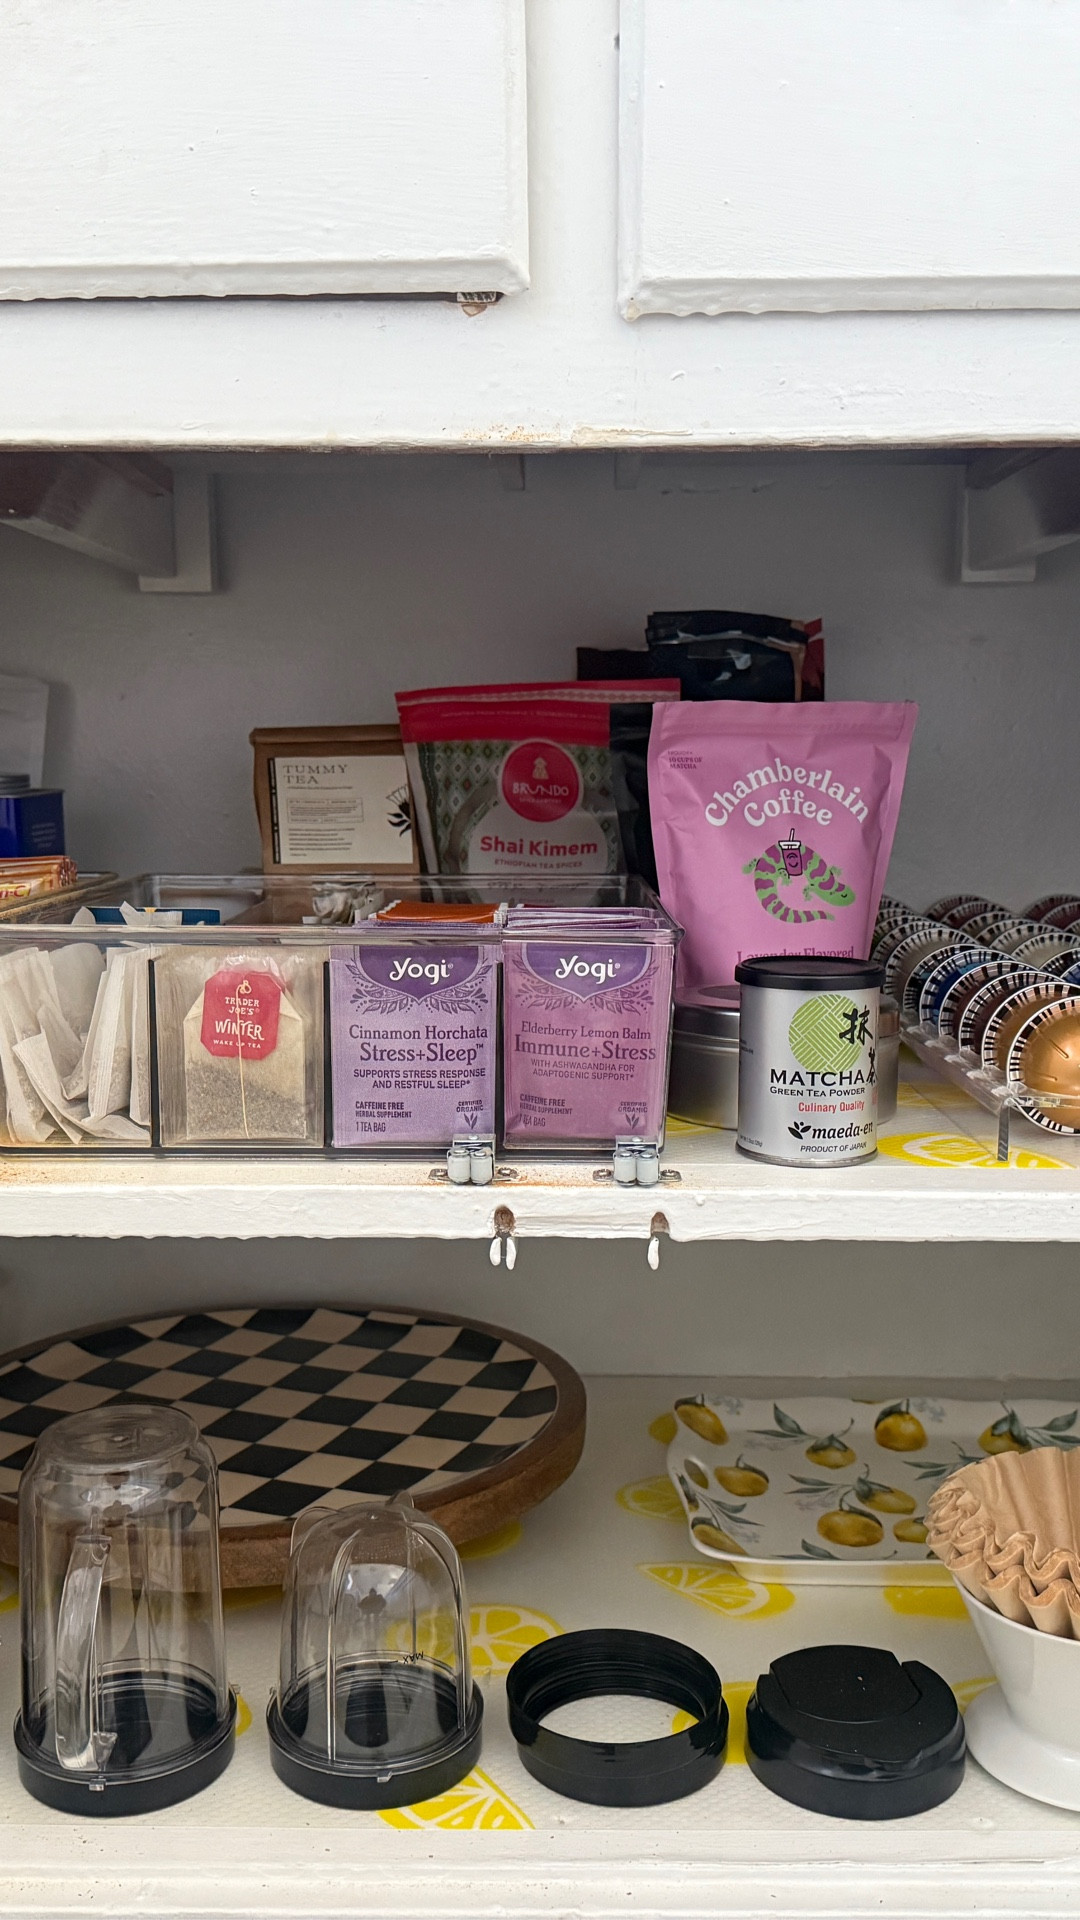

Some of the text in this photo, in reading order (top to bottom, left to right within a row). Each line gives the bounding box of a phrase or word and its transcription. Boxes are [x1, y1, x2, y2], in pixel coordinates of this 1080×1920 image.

[283, 764, 348, 774] TUMMY
[284, 775, 319, 784] TEA
[512, 782, 569, 797] BRUNDO
[705, 758, 871, 827] Chamberlain
[744, 789, 833, 827] Coffee
[481, 836, 598, 857] Shai Kimem
[494, 859, 537, 869] ETHIOPIAN
[539, 861, 554, 869] TEA
[225, 996, 260, 1007] TRADER
[215, 1018, 265, 1041] WINTER
[349, 1024, 488, 1040] Cinnamon Horchata
[521, 1021, 651, 1040] Elderberry Lemon Balm
[515, 1034, 656, 1060] Immune+Stress
[531, 1058, 635, 1072] WITH ASHWAGANDHA FOR
[353, 1067, 486, 1079] SUPPORTS STRESS RESPONSE
[532, 1068, 589, 1080] ADAPTOGENIC
[770, 1068, 865, 1086] MATCHA
[372, 1080, 392, 1089] AND
[394, 1080, 435, 1089] RESTFUL
[769, 1086, 804, 1096] GREEN
[806, 1088, 826, 1097] TEA
[829, 1088, 865, 1097] POWDER
[355, 1101, 405, 1110] CAFFEINE FREE
[458, 1099, 482, 1107] CERTIFIED
[519, 1094, 566, 1107] CAFFEINE FREE
[456, 1105, 484, 1113] ORGANIC
[537, 1106, 572, 1116] SUPPLEMENT
[798, 1100, 865, 1114] Culinary Quality
[355, 1110, 376, 1118] HERBAL
[360, 1121, 373, 1132] TEA
[373, 1121, 386, 1132] BAG
[533, 1116, 546, 1127] BAG
[800, 1142, 867, 1152] PRODUCT OF JAPAN
[402, 1650, 424, 1664] MAX
